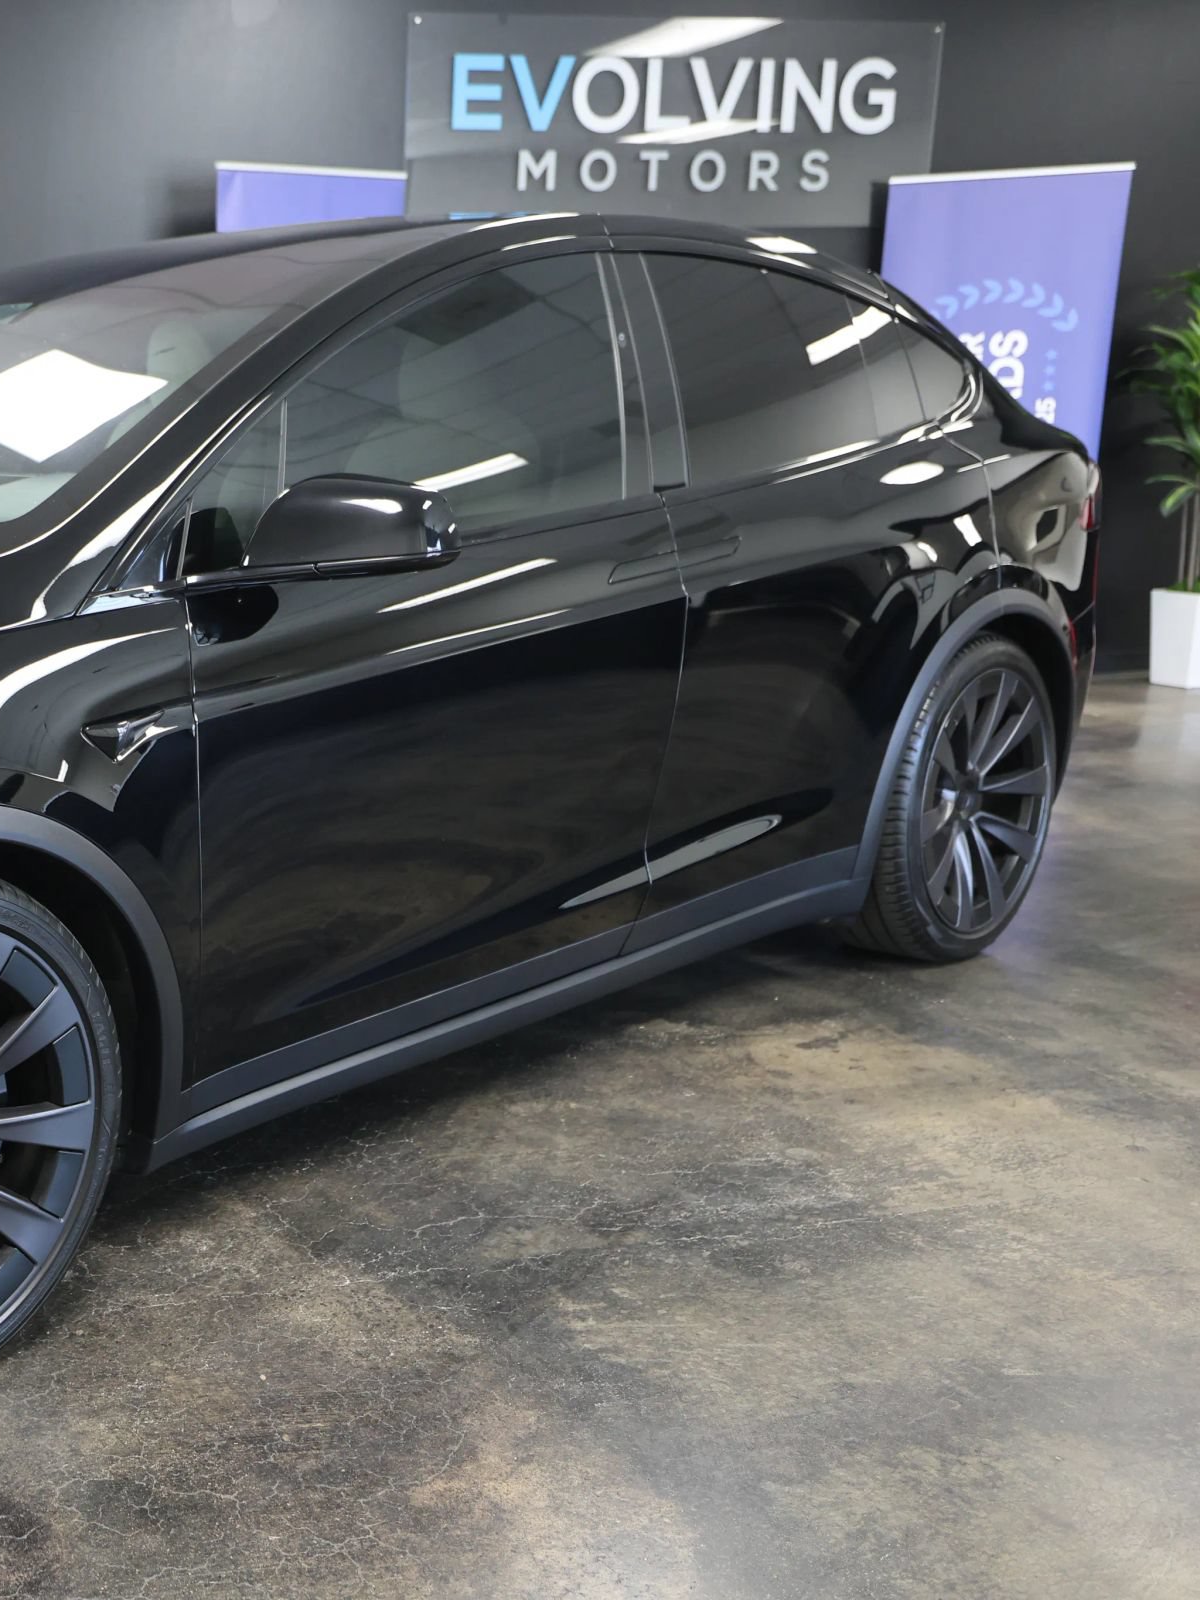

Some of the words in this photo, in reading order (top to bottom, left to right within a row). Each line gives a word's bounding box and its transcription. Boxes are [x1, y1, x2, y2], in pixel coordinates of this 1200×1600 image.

[451, 53, 898, 135] EVOLVING
[516, 149, 831, 192] MOTORS
[988, 329, 1029, 399] DS
